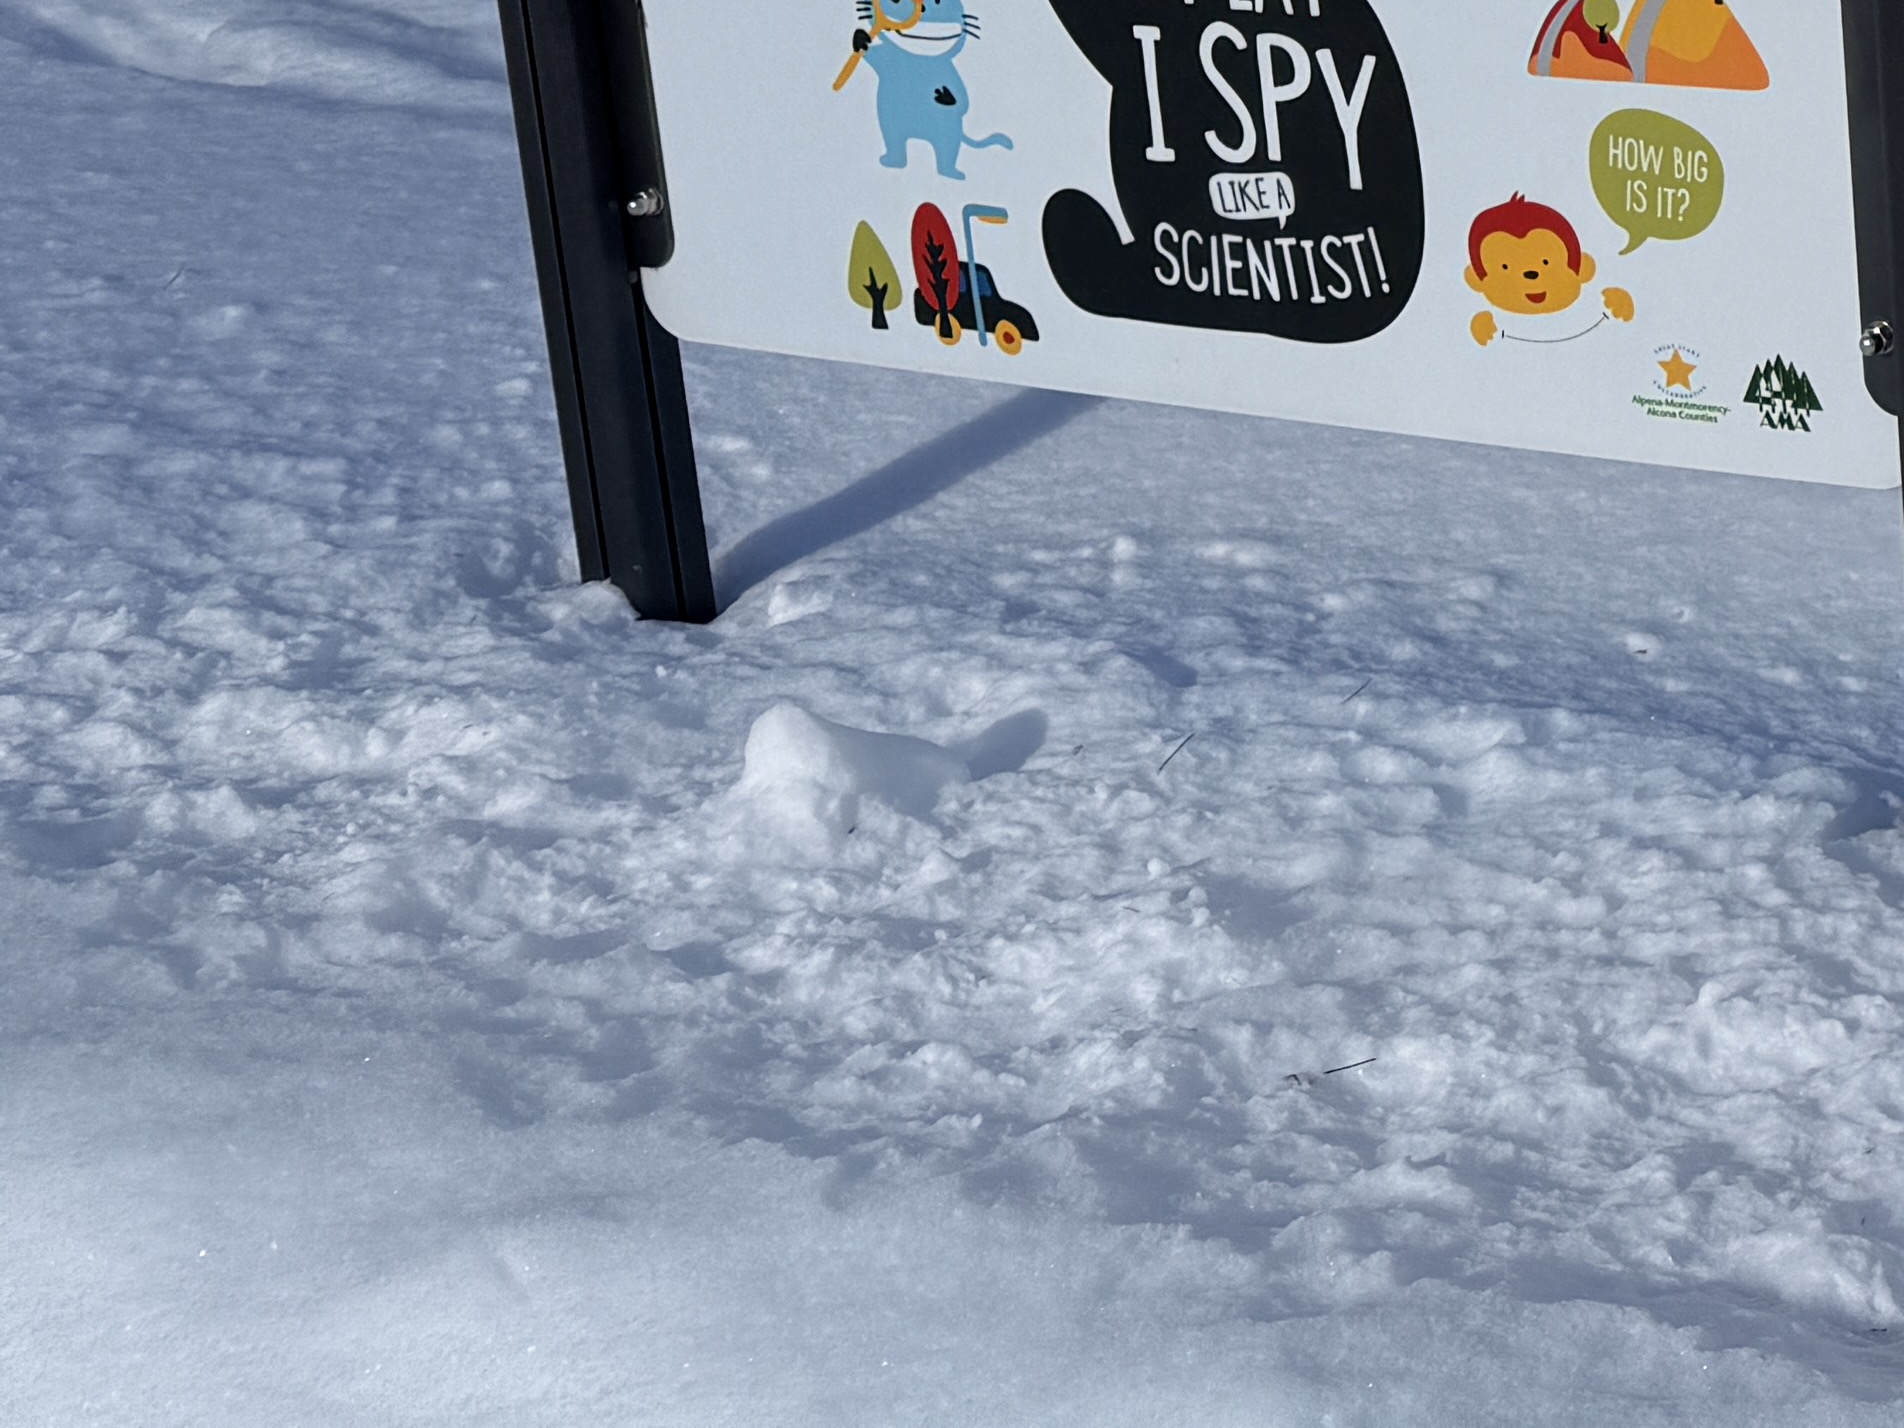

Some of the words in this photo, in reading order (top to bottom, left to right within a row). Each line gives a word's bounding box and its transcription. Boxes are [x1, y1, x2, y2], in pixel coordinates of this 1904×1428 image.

[1132, 24, 1176, 162] I
[1199, 20, 1377, 191] SPY
[1609, 134, 1664, 175] HOW
[1673, 146, 1708, 183] BIG
[1216, 178, 1271, 215] LIKE
[1276, 176, 1293, 210] A
[1626, 179, 1647, 213] IS
[1657, 186, 1690, 221] IT?
[1152, 221, 1391, 305] SCIENTIST!
[1760, 409, 1811, 433] AMA
